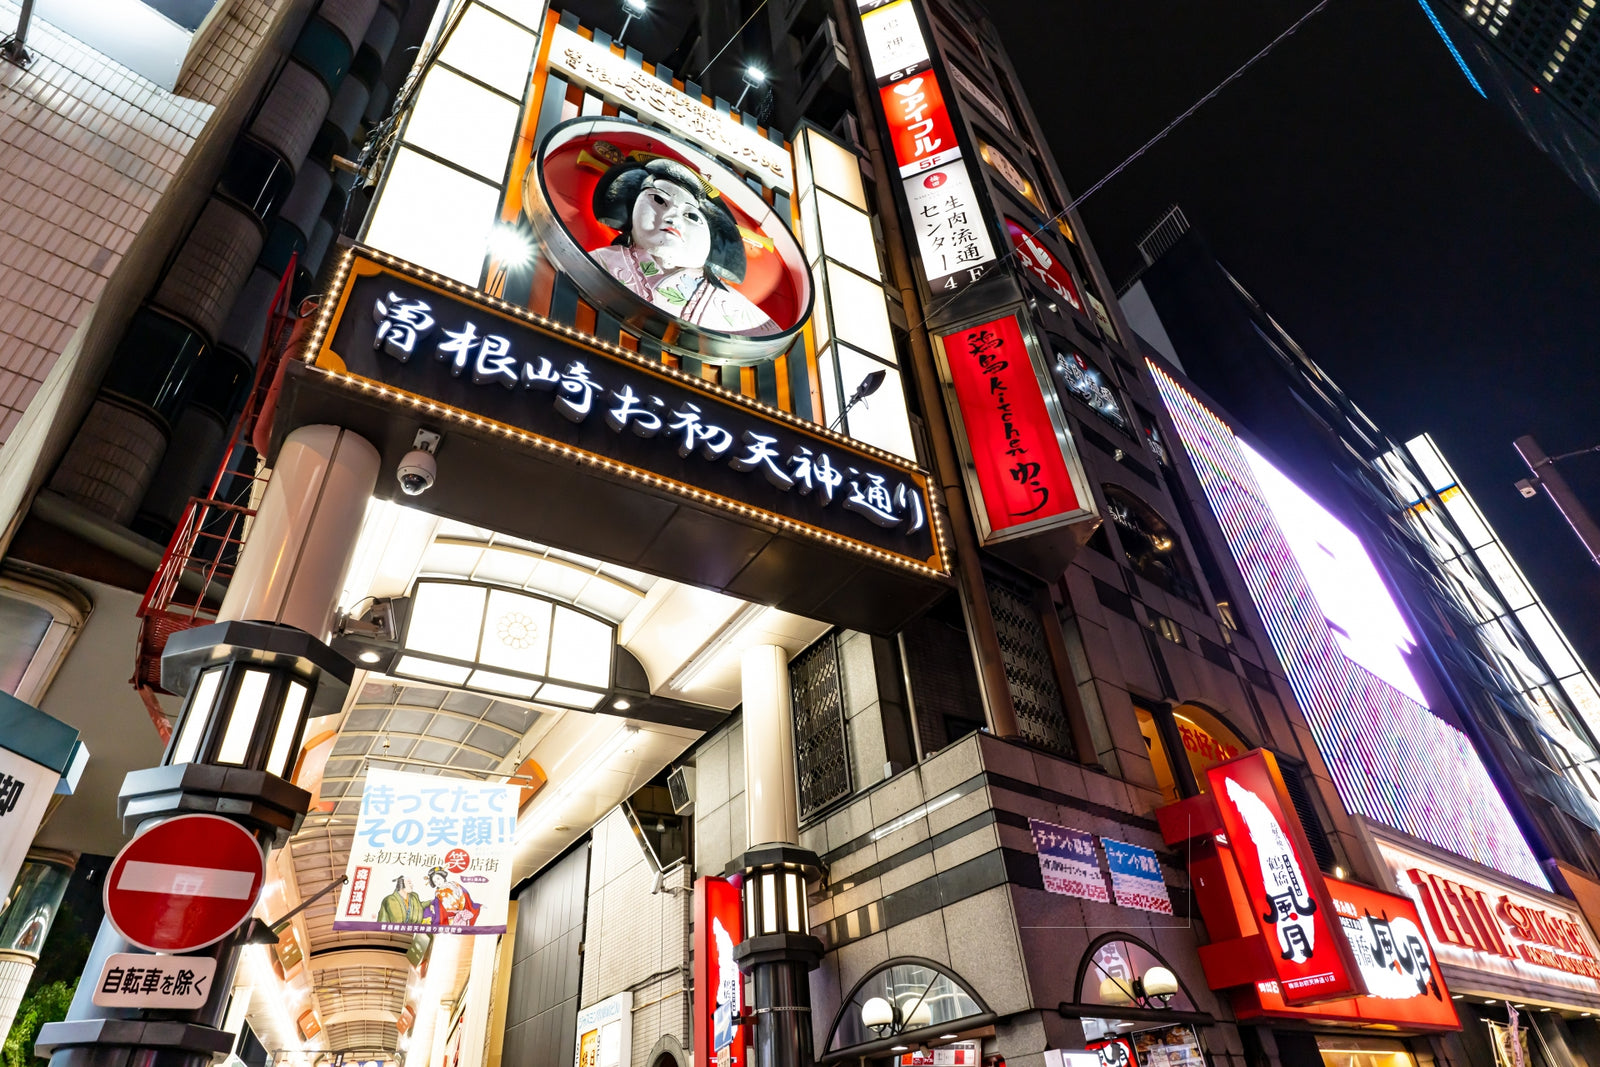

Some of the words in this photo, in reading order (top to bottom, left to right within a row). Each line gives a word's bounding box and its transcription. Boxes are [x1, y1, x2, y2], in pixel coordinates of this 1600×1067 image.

[889, 64, 919, 82] 6F
[899, 91, 942, 158] アイフル
[919, 156, 943, 170] 5F
[919, 204, 948, 271] センター
[943, 195, 985, 265] 生肉流通
[374, 290, 926, 537] 曽根崎お初天神通り
[357, 815, 517, 848] その笑顔!!
[360, 783, 508, 816] 待ってたで
[1263, 886, 1318, 961] 風月
[1407, 868, 1521, 960] ZETTA
[101, 966, 207, 997] 自転車を除く
[1362, 907, 1443, 1003] 風月
